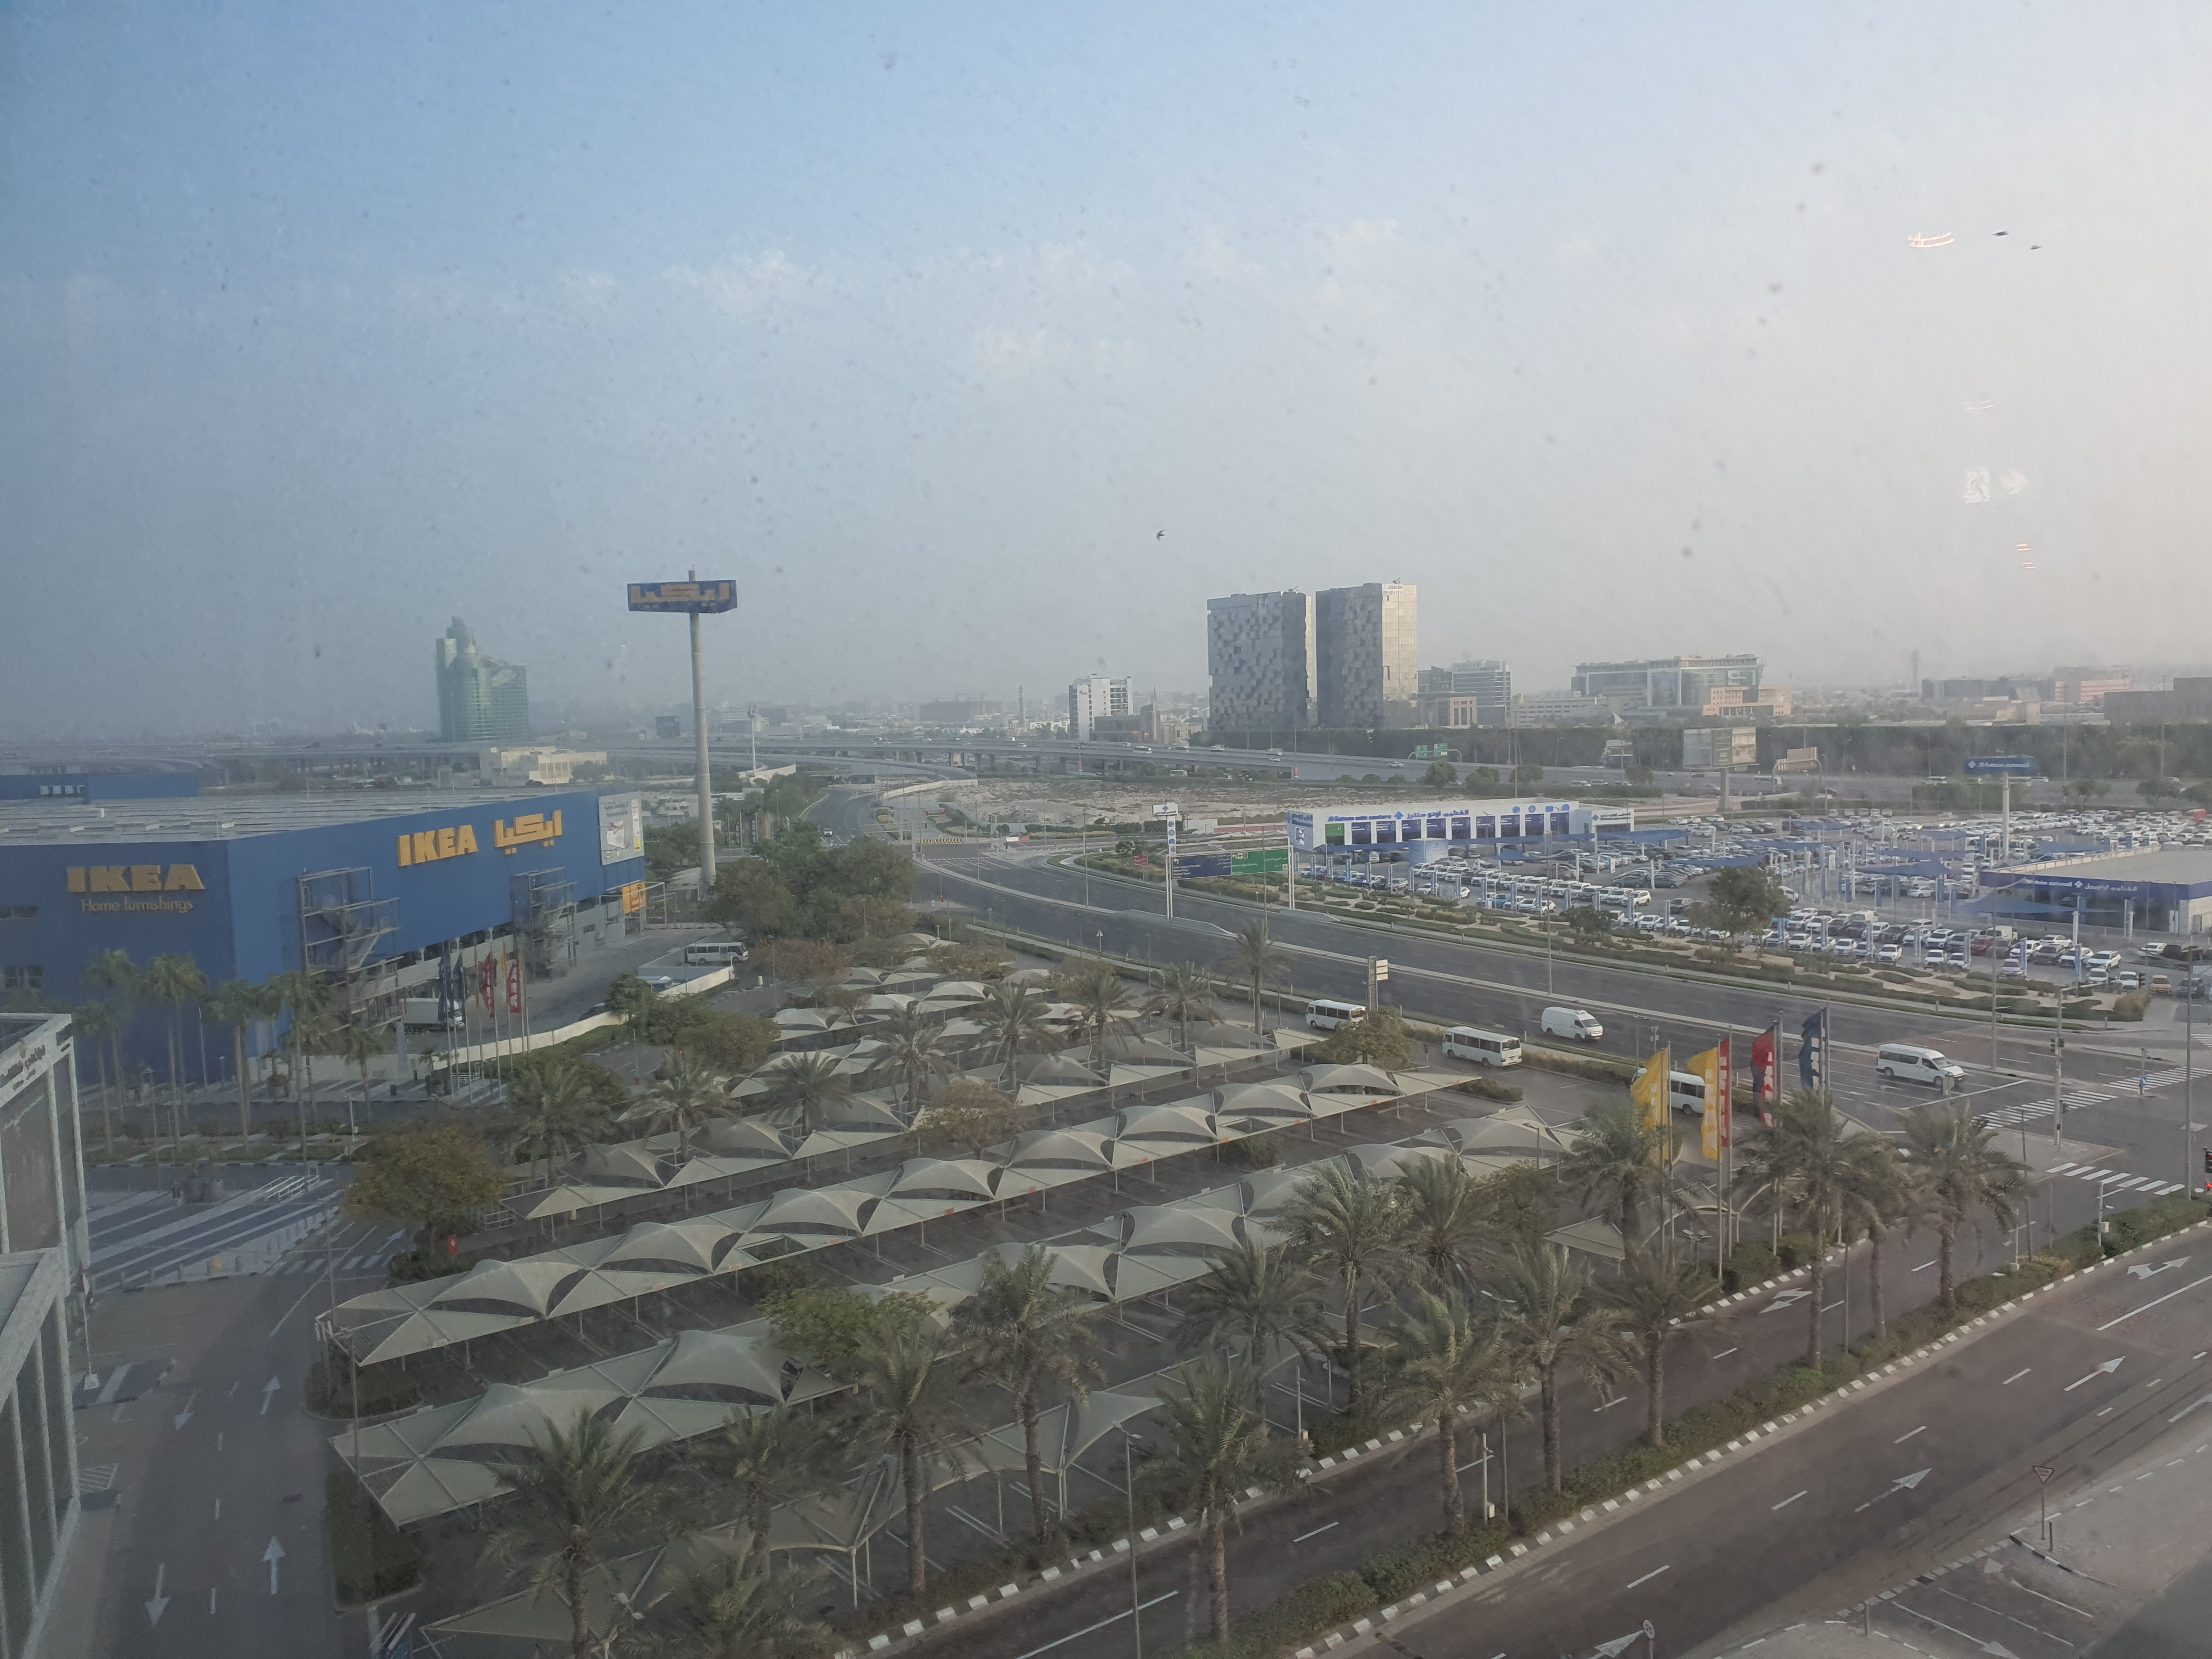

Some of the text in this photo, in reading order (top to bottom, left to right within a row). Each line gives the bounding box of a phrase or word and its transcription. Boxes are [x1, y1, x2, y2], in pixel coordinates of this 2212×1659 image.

[397, 825, 479, 867] IKEA
[67, 865, 206, 893] IKEA
[81, 896, 193, 913] Home furnishings
